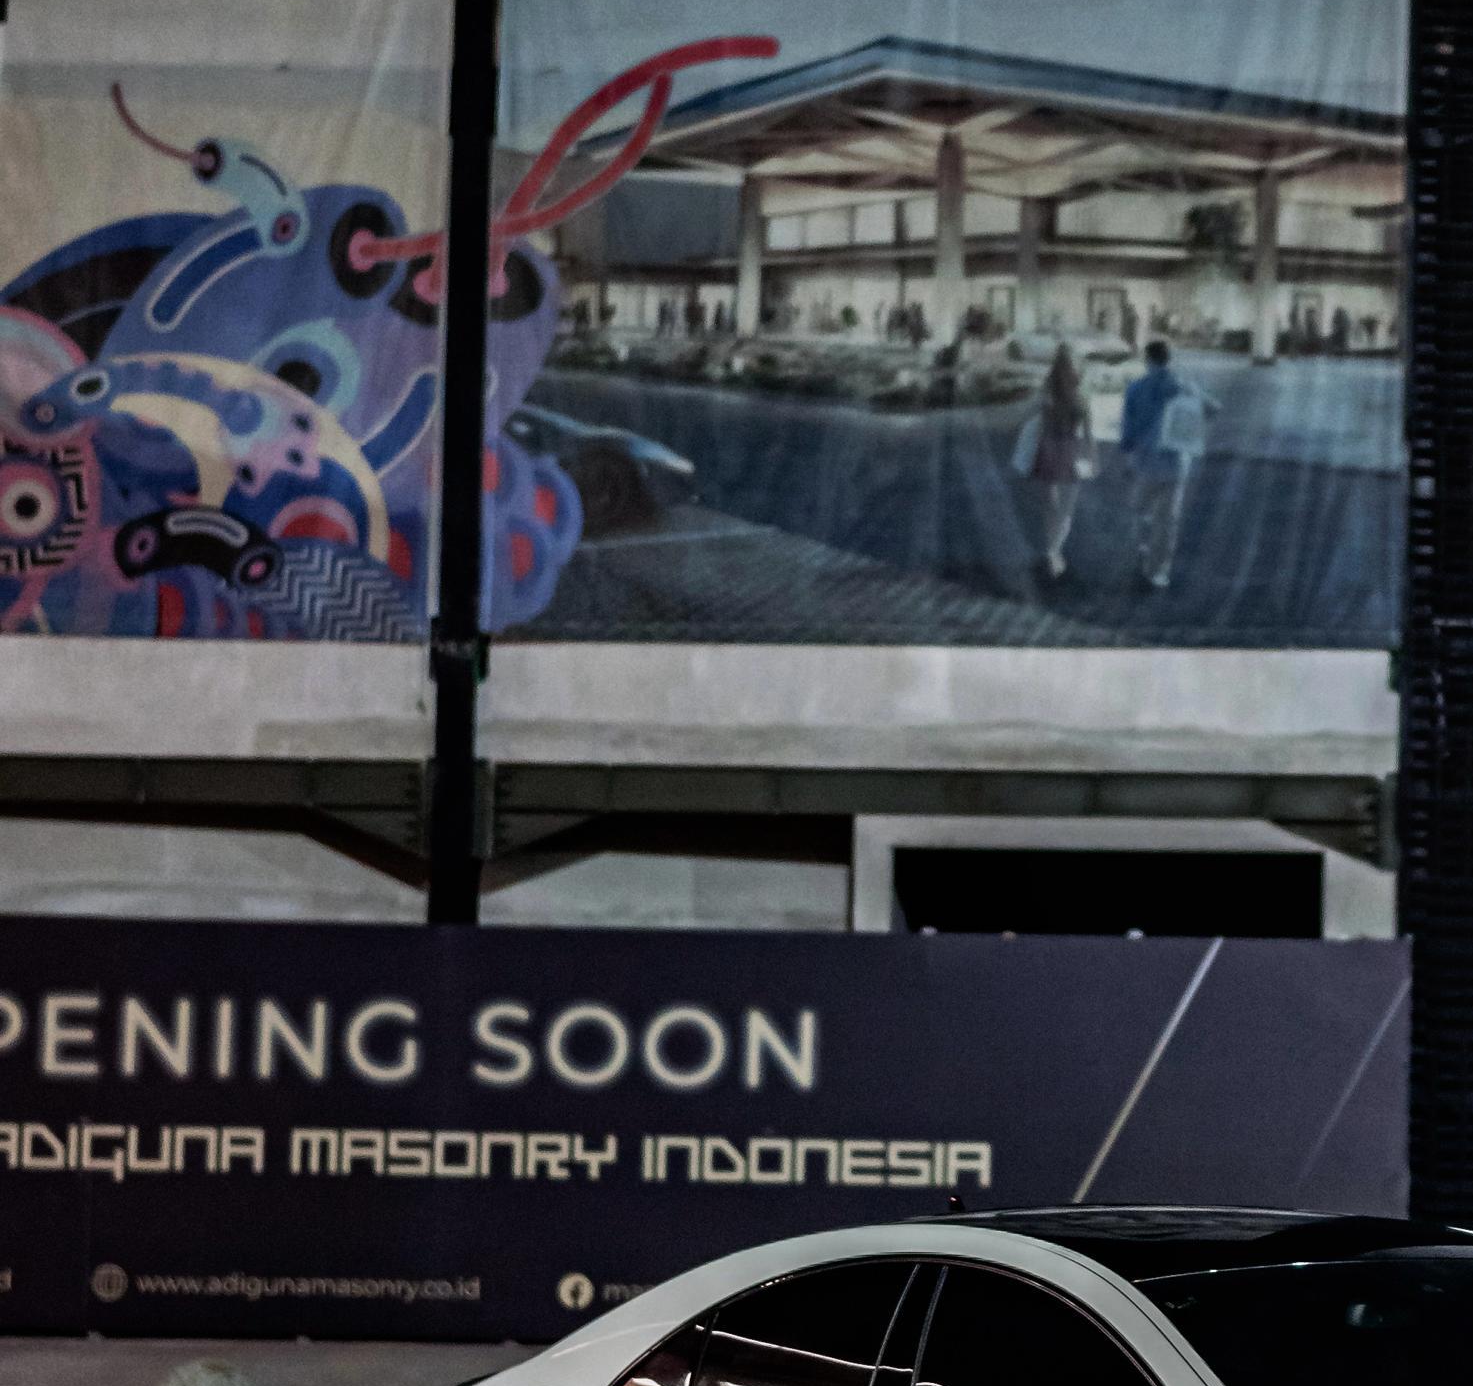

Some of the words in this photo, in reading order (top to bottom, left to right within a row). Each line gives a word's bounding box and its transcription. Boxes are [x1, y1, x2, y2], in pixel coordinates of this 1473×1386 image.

[473, 1002, 818, 1091] SOON
[290, 1128, 618, 1181] MASONRY
[642, 1135, 993, 1188] INDONESIA
